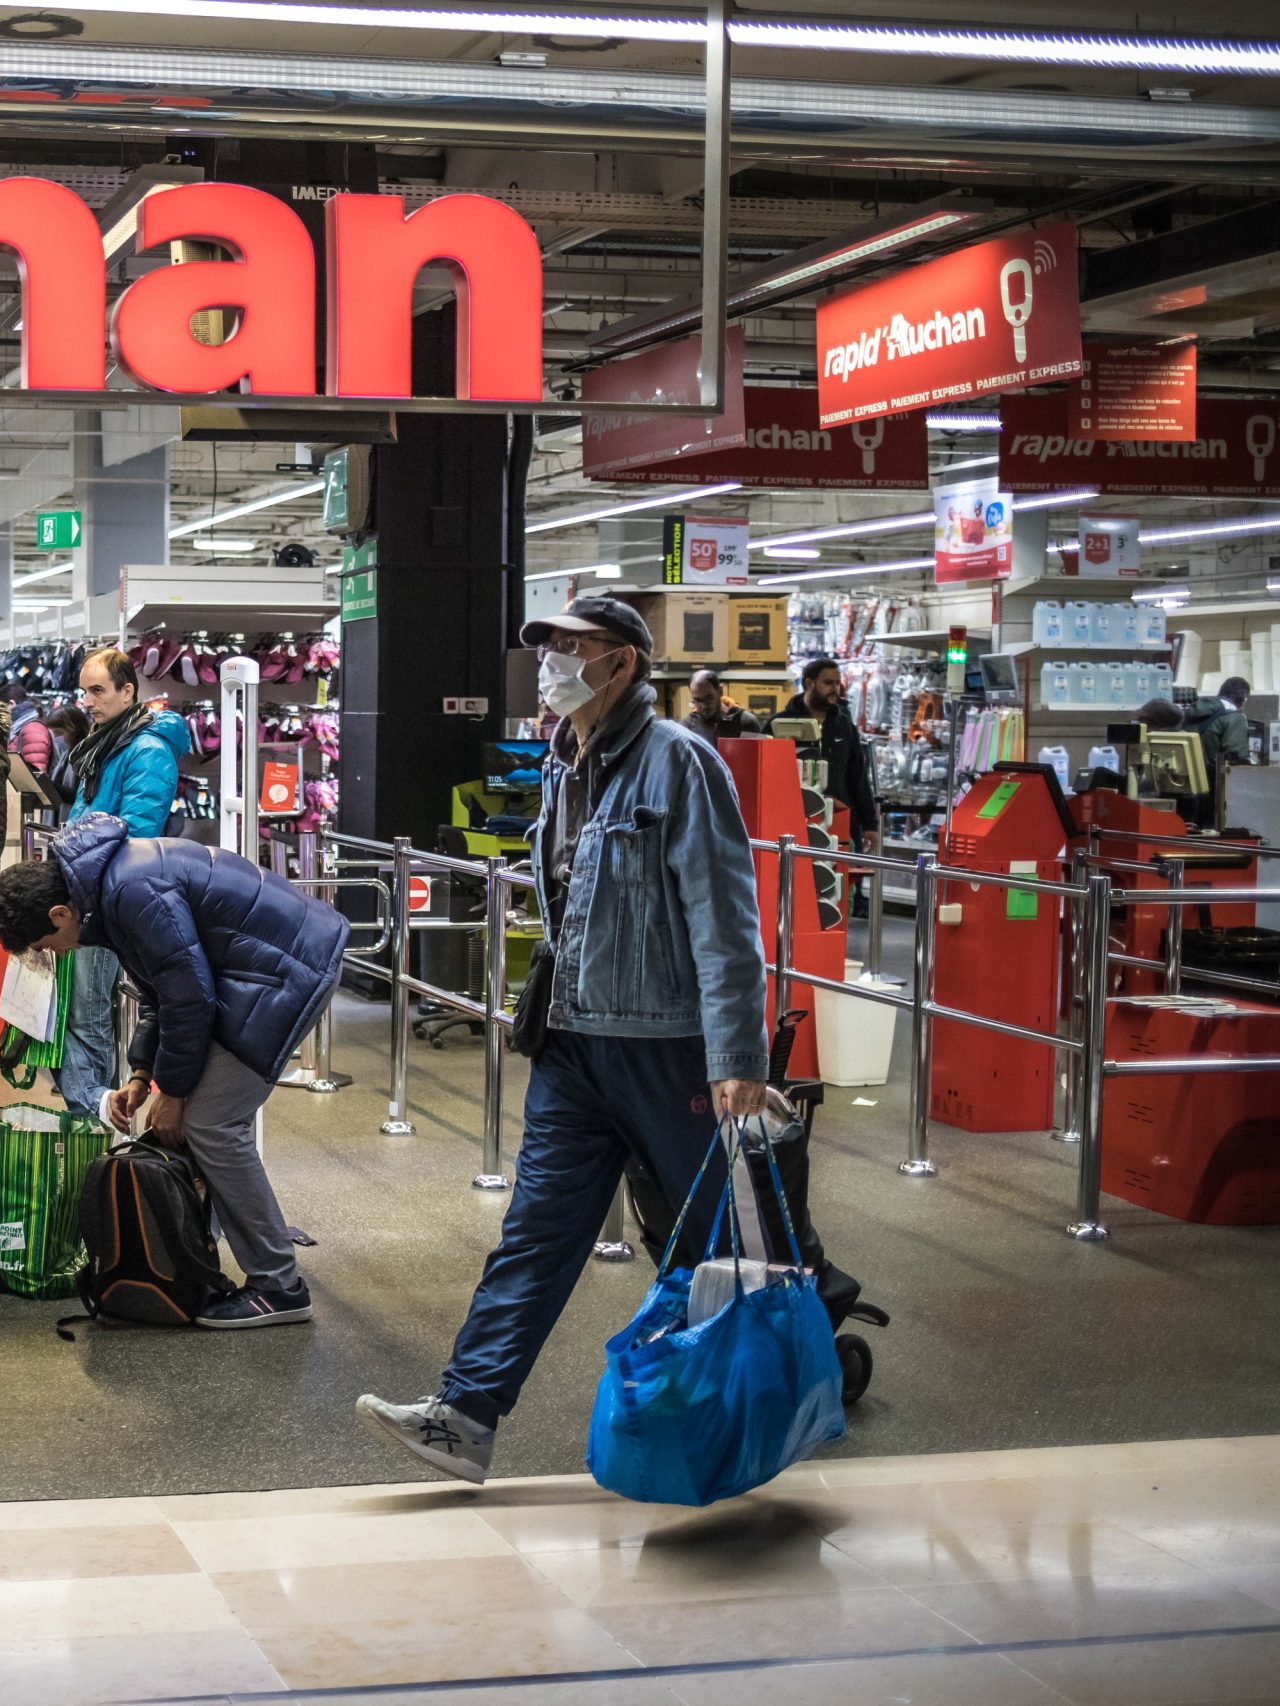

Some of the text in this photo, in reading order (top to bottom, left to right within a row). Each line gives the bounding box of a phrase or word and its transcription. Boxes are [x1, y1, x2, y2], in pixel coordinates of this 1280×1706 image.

[820, 360, 1081, 425] PAIEMENT EXPRESS PAIEMENT EXPRESS PAIEMENT EXPRESS
[763, 477, 813, 485] EXPRESS
[1086, 538, 1109, 550] 2+1
[0, 1225, 23, 1233] POINT
